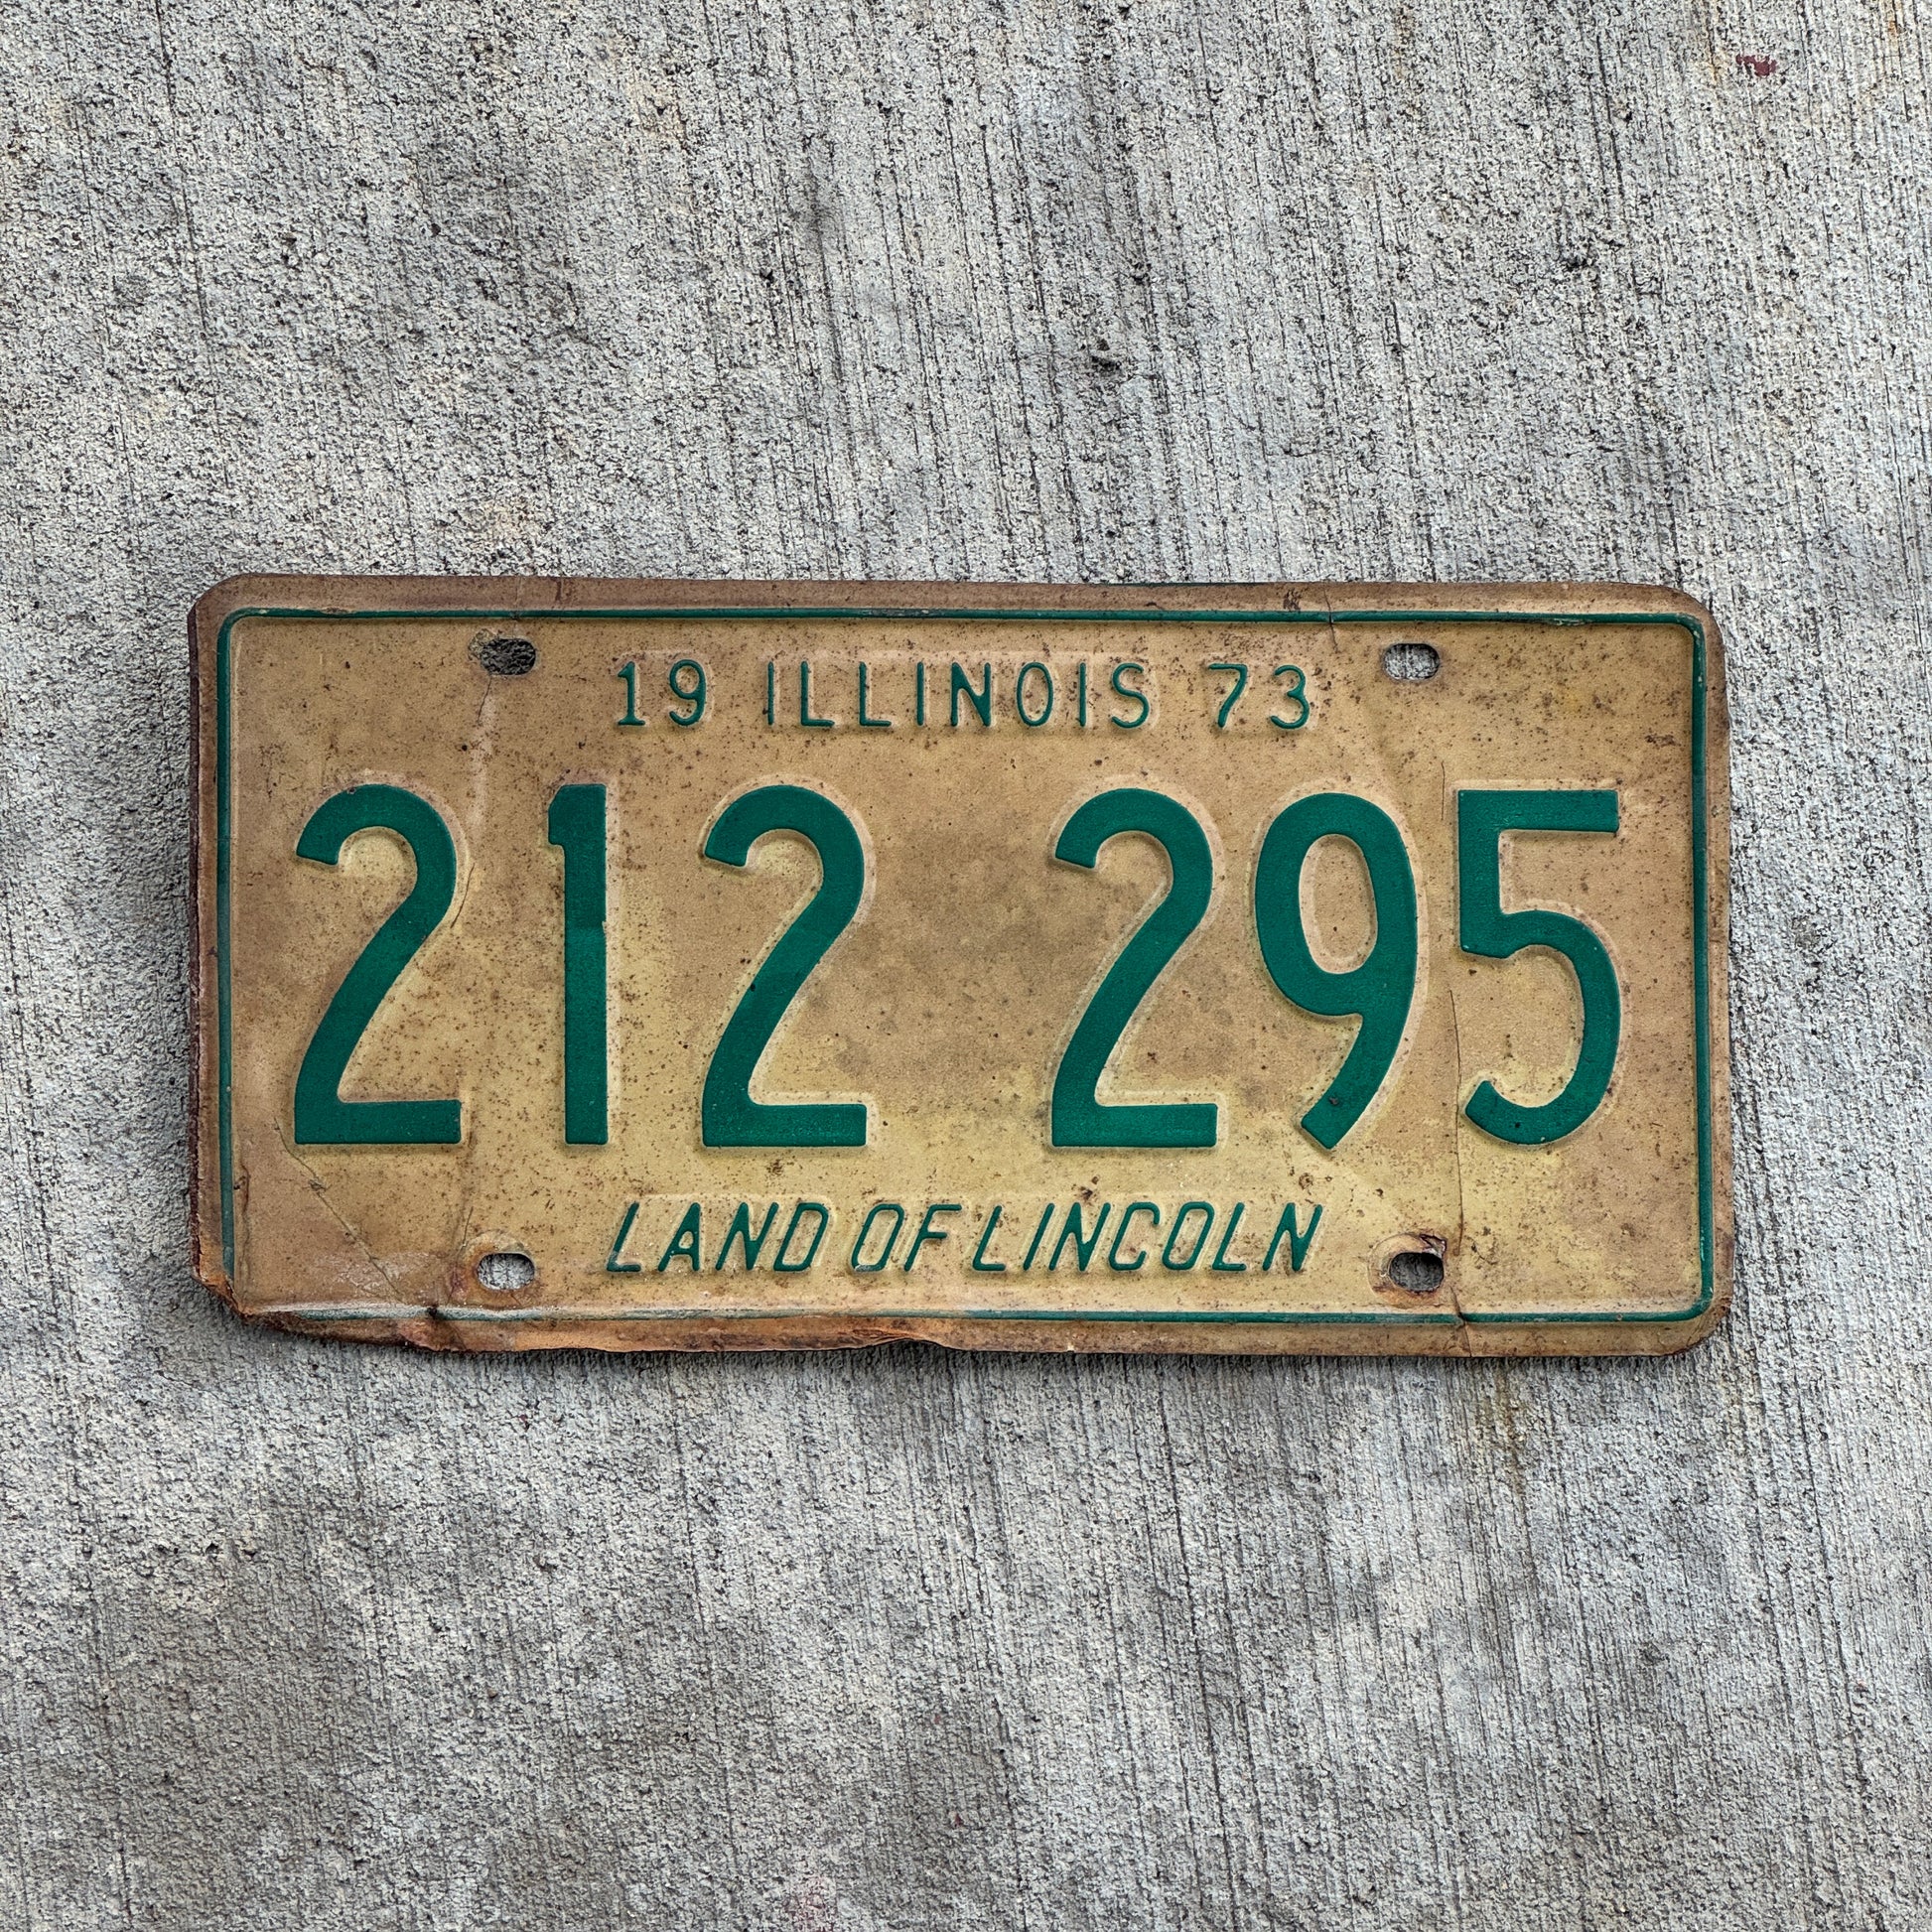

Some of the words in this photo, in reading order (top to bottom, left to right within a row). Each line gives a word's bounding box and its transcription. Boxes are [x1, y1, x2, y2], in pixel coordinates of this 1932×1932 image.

[617, 659, 706, 727] 19
[766, 660, 1150, 729] ILLINOIS
[1207, 662, 1311, 730] 73
[294, 783, 868, 1148] 212
[1050, 787, 1621, 1150] 295
[606, 1201, 830, 1273] LAND
[851, 1202, 962, 1272] OF
[970, 1201, 1323, 1272] LINCOLN
